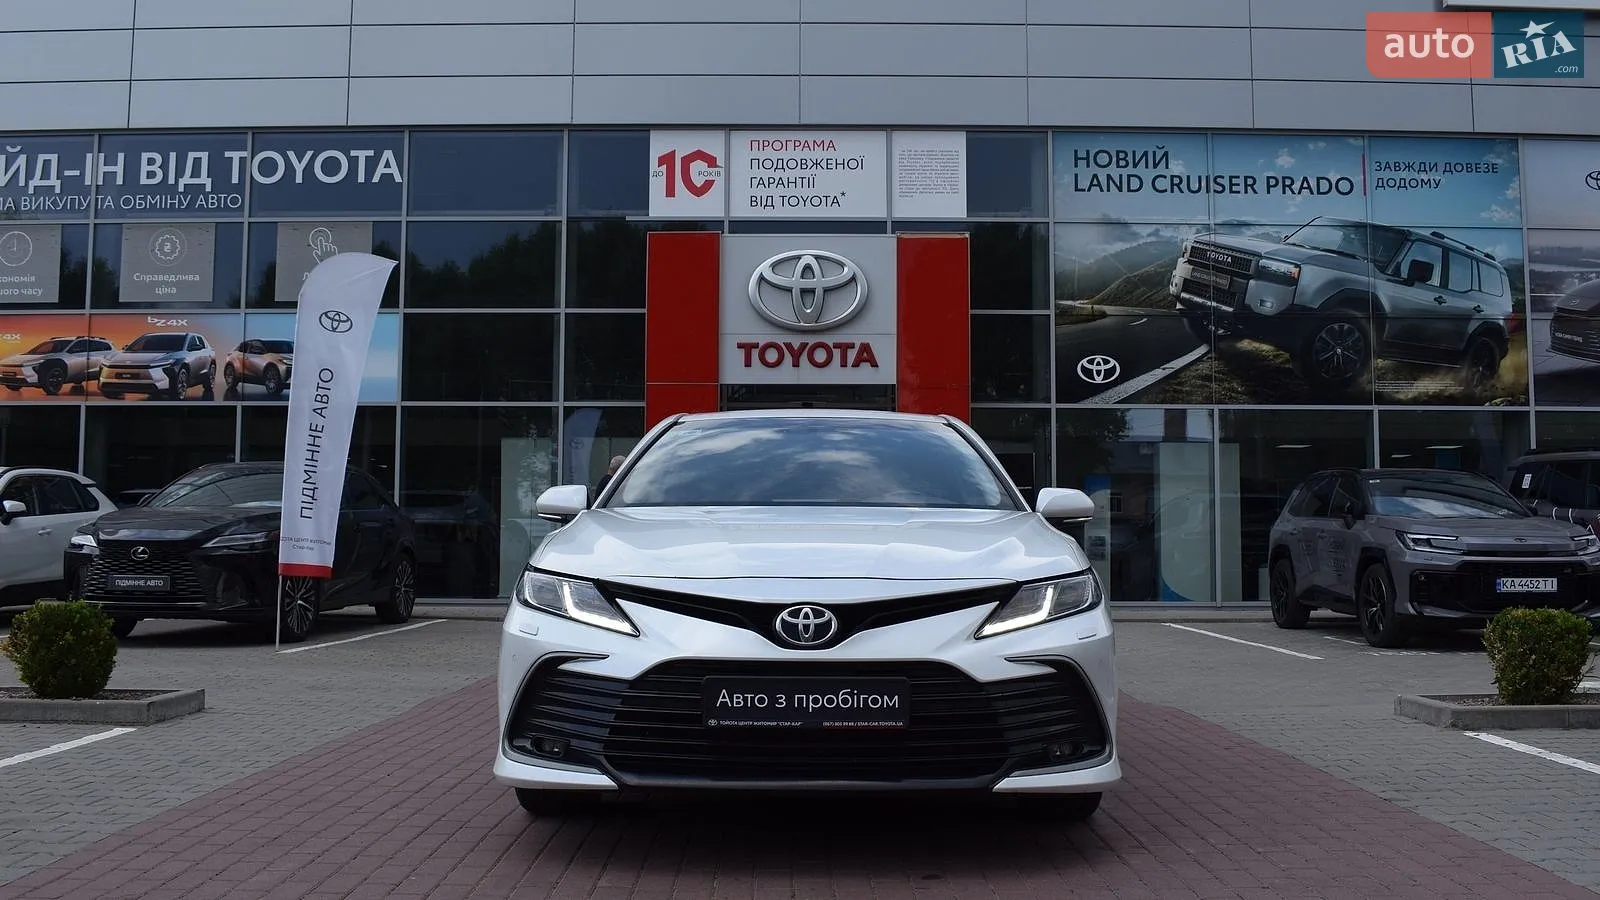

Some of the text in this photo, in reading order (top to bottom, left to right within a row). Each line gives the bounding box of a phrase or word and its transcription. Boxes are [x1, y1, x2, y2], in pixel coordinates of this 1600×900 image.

[749, 139, 837, 152] ПРОГРАМА
[749, 154, 865, 173] ПОДОВЖЕНОЇ
[1073, 144, 1170, 170] НОВИЙ
[140, 151, 212, 192] ВІД
[224, 149, 403, 185] TOYOTA
[697, 170, 722, 178] РОКІВ
[1374, 160, 1500, 176] ЗАВЖДИ ДОВЕЗЕ
[749, 174, 817, 189] ГАРАНТІЇ
[1073, 173, 1355, 197] LAND CRUISER PRADO
[1374, 176, 1443, 192] ДОДОМУ
[21, 195, 91, 211] ВИКУПУ
[96, 194, 115, 211] ТА
[120, 194, 193, 210] ОБМІНУ
[196, 193, 242, 209] АВТО
[749, 194, 775, 210] ВІД
[1206, 251, 1232, 263] TOYOTA
[133, 273, 200, 285] Справедлива
[155, 284, 177, 296] ціна
[736, 341, 879, 369] TOYOTA
[299, 367, 334, 521] ПІДМІННЕ АВТО
[1518, 579, 1541, 590] 4452
[716, 688, 899, 713] Авто з пробігом
